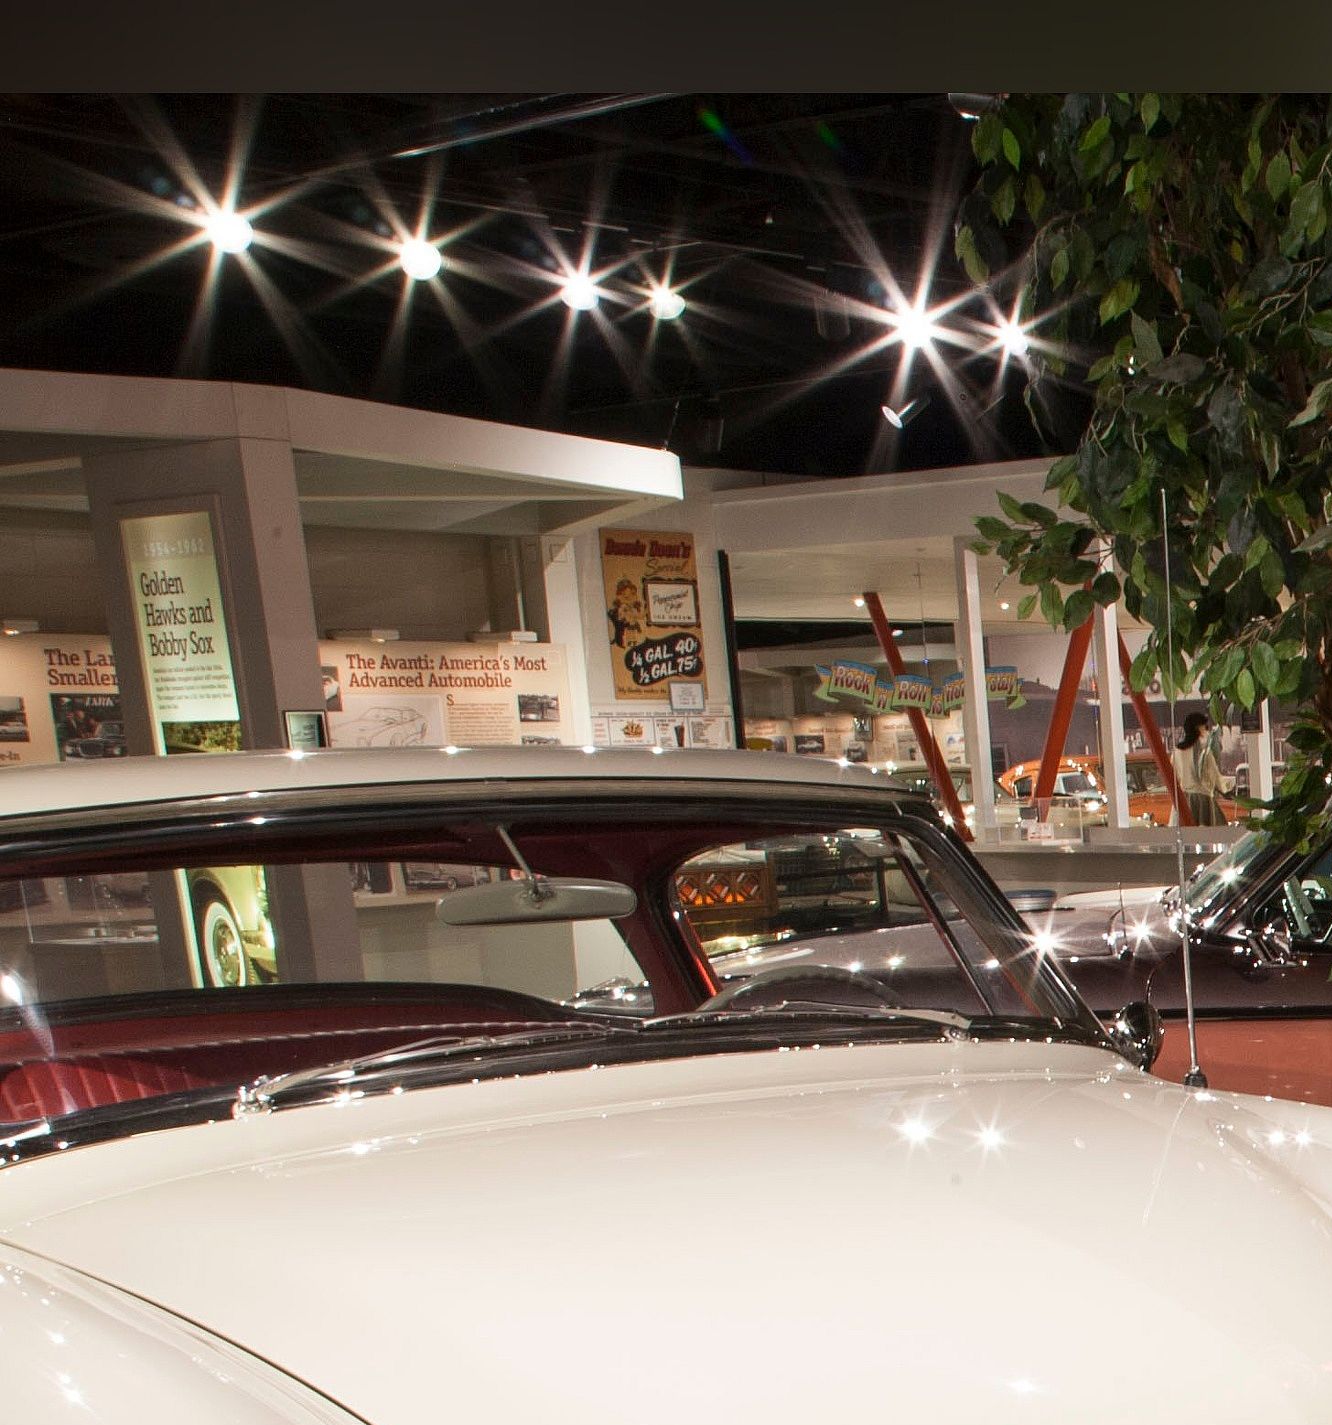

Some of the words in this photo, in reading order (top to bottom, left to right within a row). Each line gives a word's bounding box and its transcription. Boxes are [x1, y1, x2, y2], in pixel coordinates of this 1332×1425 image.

[140, 572, 184, 597] Golden
[144, 602, 187, 627] Hawks
[189, 598, 213, 623] and
[44, 648, 80, 666] The
[148, 633, 187, 661] Bobby
[190, 631, 215, 654] Sox
[346, 654, 376, 670] The
[380, 654, 434, 671] Avanti:
[439, 655, 510, 671] America's
[513, 656, 548, 671] Most
[349, 673, 424, 688] Advanced
[428, 672, 512, 688] Automobile
[834, 665, 870, 695] Rock
[898, 680, 926, 702] Roll
[989, 673, 1014, 695] stay
